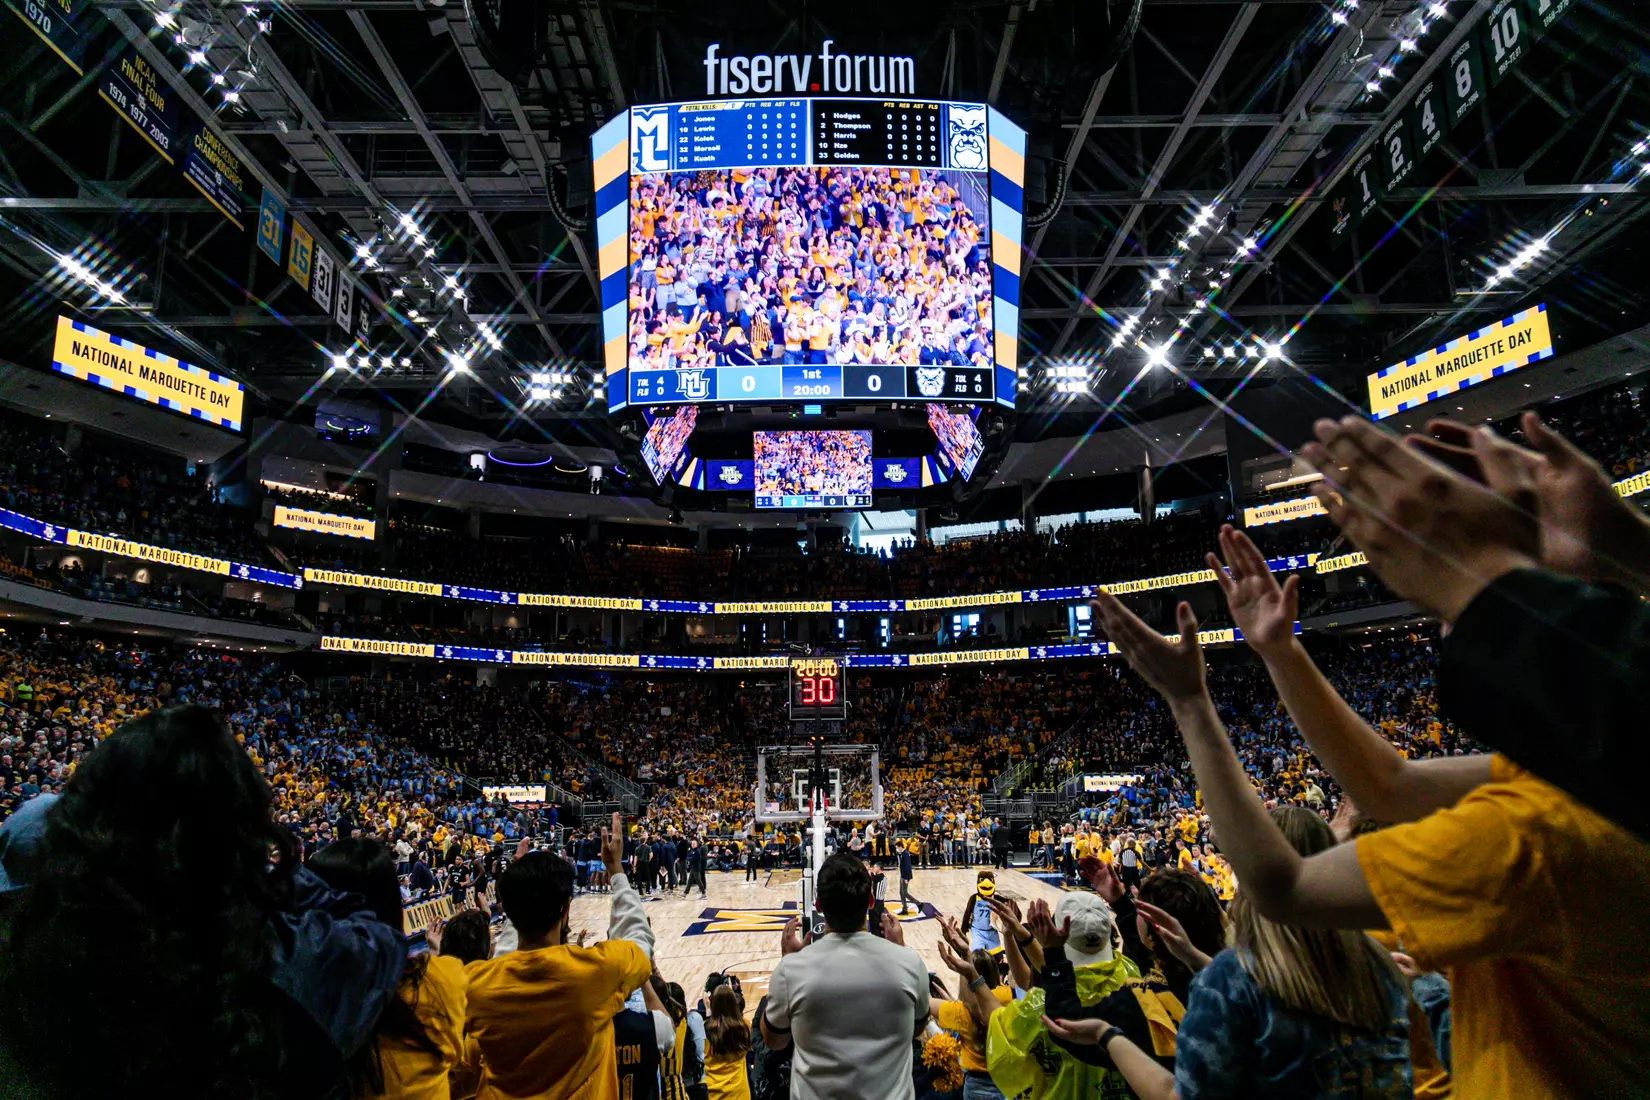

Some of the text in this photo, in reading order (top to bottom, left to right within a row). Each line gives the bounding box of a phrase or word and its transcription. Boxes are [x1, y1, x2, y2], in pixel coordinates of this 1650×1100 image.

[24, 0, 51, 33] 1970
[1490, 7, 1520, 63] 10
[135, 54, 156, 87] NCAA
[1455, 59, 1472, 98] 8
[121, 58, 165, 112] FINAL FOUR
[109, 82, 169, 149] 1974 1977 2003
[833, 122, 871, 130] Thompson
[1422, 99, 1436, 135] 4
[202, 126, 241, 173] CONFERENCE
[1390, 136, 1404, 173] 2
[194, 134, 244, 192] CHAMPIONSHIPS
[1360, 170, 1371, 203] 1
[262, 207, 280, 249] 31
[292, 238, 309, 275] 15
[318, 265, 331, 297] 31
[341, 290, 349, 316] 3
[72, 340, 230, 408] NATIONAL MARQUETTE DAY
[802, 369, 821, 379] 1st
[1381, 328, 1532, 399] NATIONAL MARQUETTE DAY
[637, 377, 664, 387] TOL 4
[741, 375, 755, 392] 0
[867, 375, 882, 392] 0
[955, 374, 982, 383] TOL 4
[955, 384, 982, 393] FLS 0
[637, 387, 664, 396] FLS 0
[793, 385, 830, 395] 20:00
[1255, 502, 1318, 519] NATIONAL MARQUETTE
[286, 513, 364, 532] NATIONAL MARQUETTE DAY
[78, 534, 222, 572] NATIONAL MARQUETTE DAY
[313, 571, 434, 593] NATIONAL MARQUETTE DAY
[1107, 571, 1213, 593] NATIONAL MARQUETTE DAY
[526, 595, 635, 608] NATIONAL MARQUETTE DAY
[722, 603, 825, 612] NATIONAL MARQUETTE DAY
[912, 594, 1014, 608] NATIONAL MARQUETTE DAY
[323, 638, 426, 655] ONAL MARQUETTE DAY
[1209, 631, 1225, 641] DAY
[519, 654, 632, 665] NATIONAL MARQUETTE DAY
[721, 659, 759, 667] NATIONAL
[916, 650, 1021, 663] NATIONAL MARQUETTE DAY
[797, 663, 837, 676] 20:00
[803, 678, 833, 702] 30
[407, 900, 447, 929] NATIONAL
[979, 909, 990, 918] 77
